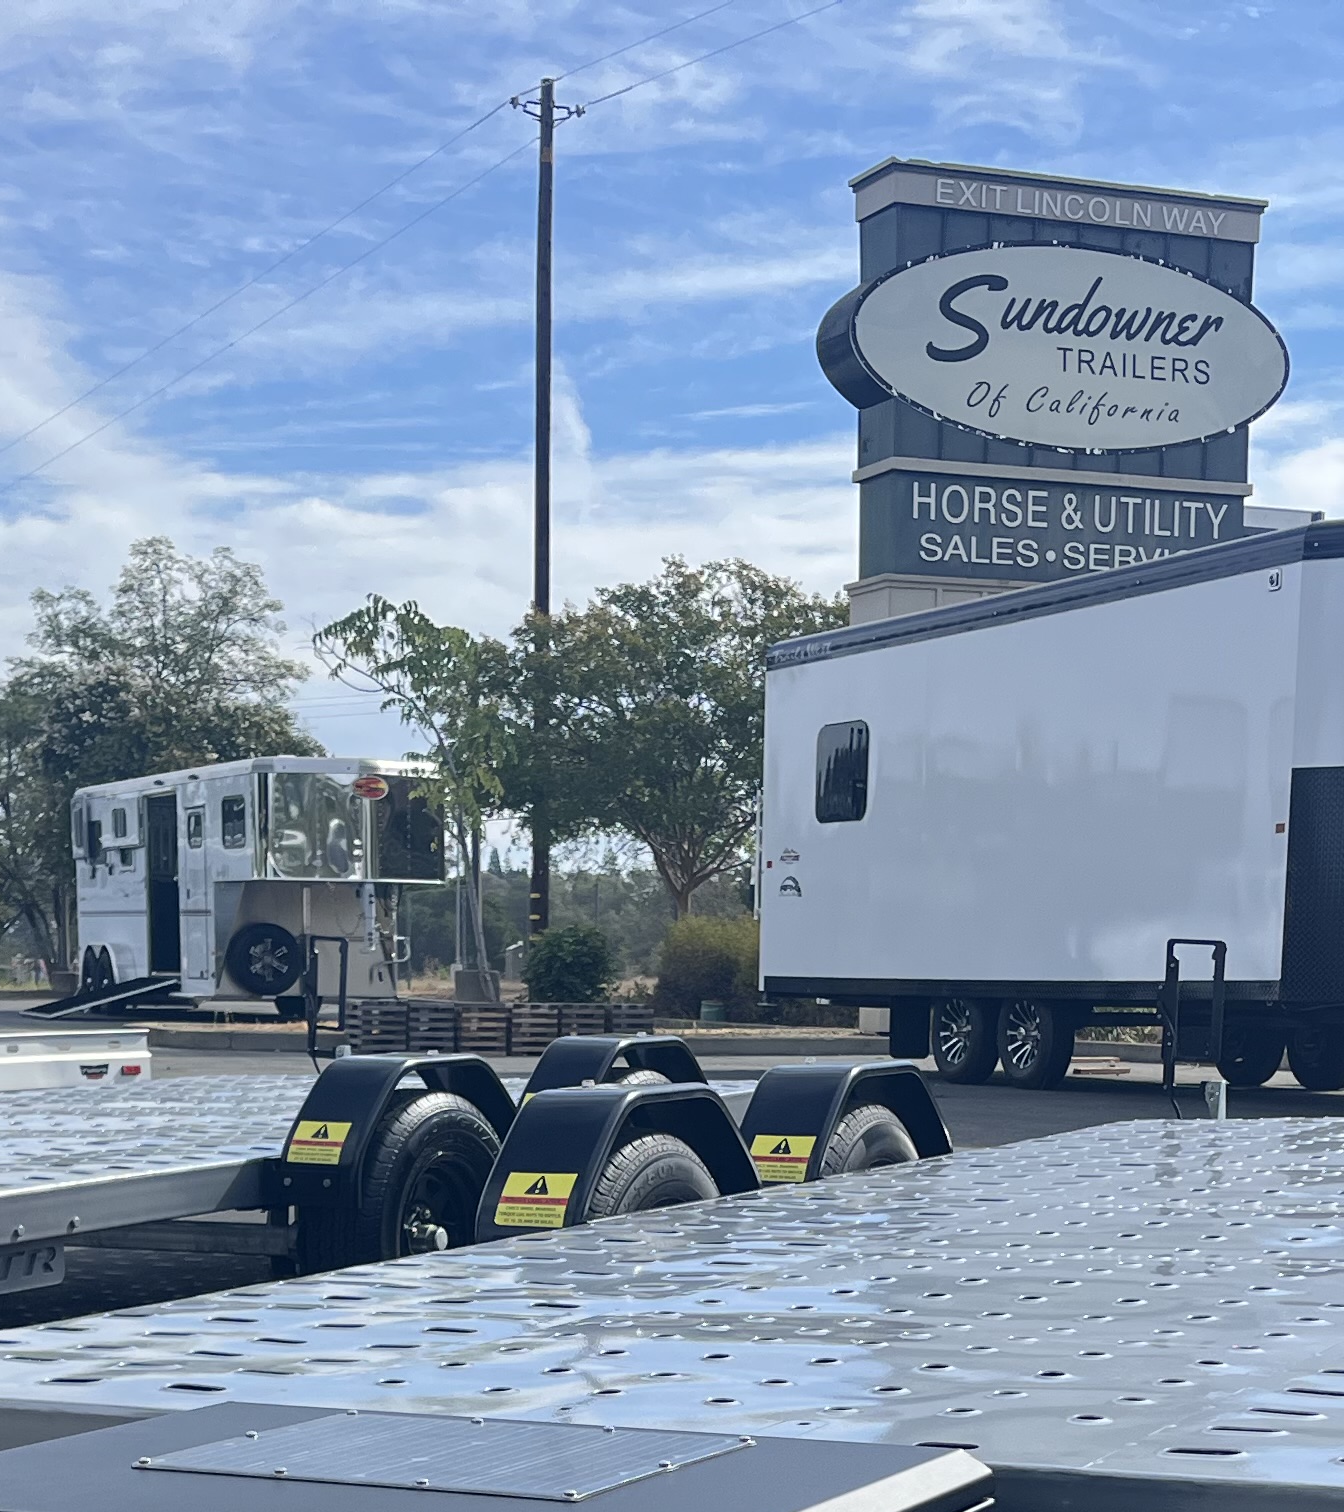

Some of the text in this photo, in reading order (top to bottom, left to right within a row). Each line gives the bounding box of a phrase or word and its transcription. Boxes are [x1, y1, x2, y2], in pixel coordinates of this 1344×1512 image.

[935, 178, 1228, 236] EXIT LINCOLN WAY
[926, 274, 1224, 363] Sundowner
[1056, 347, 1212, 386] TRAILERS
[966, 380, 1180, 426] Of California
[912, 481, 1229, 539] HORSE & UTILITY
